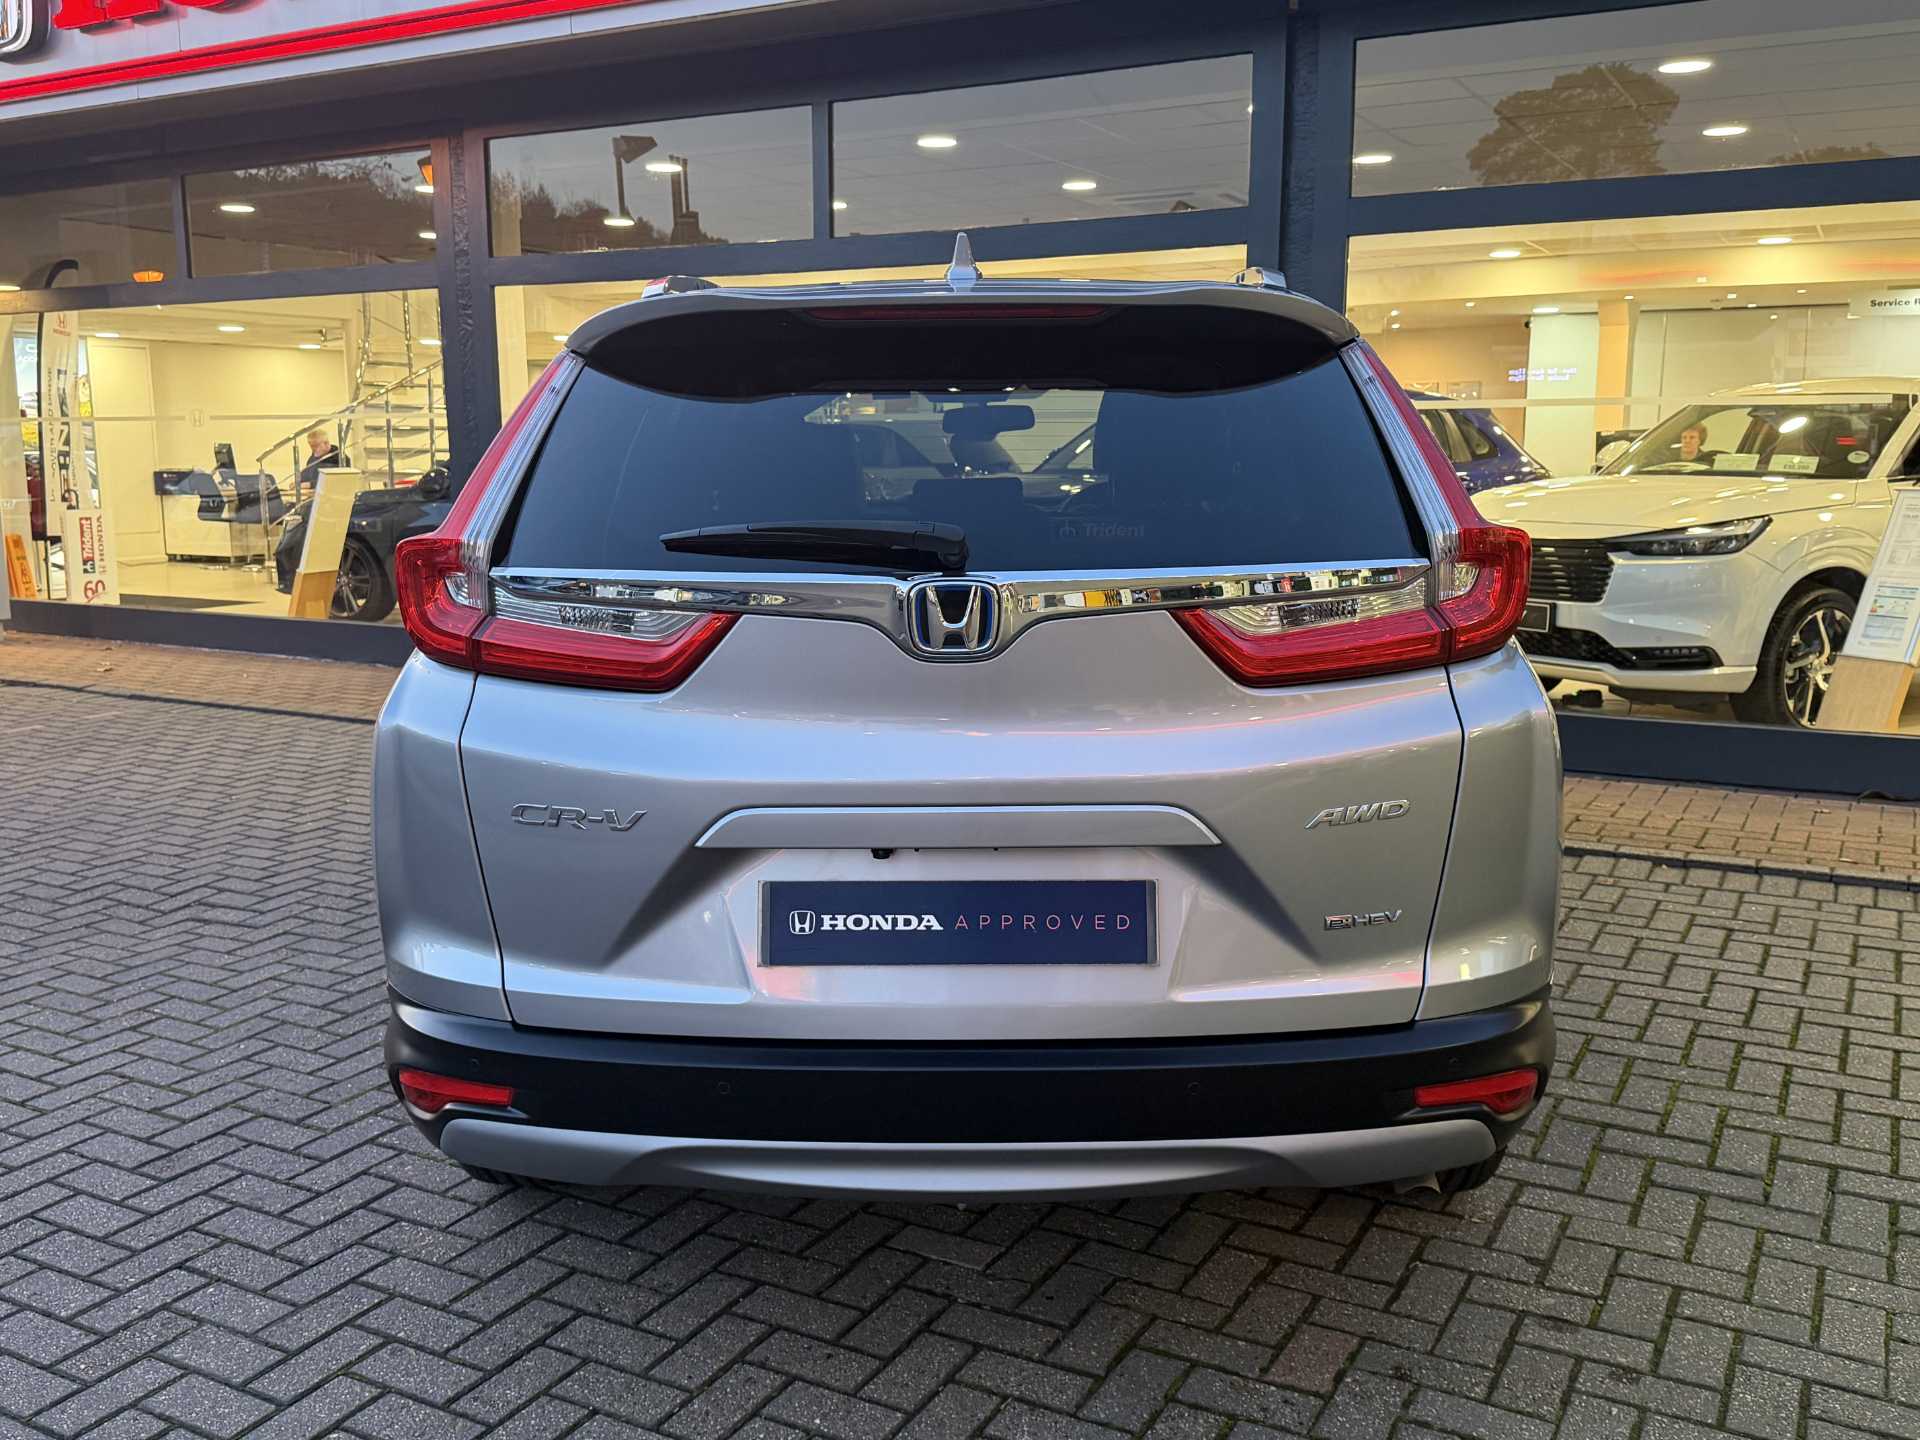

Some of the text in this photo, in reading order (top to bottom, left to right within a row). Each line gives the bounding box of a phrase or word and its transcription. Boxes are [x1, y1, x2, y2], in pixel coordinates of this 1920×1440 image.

[1870, 298, 1911, 308] Service
[81, 517, 94, 560] Trident
[96, 514, 105, 562] HONDA
[1085, 521, 1146, 538] Trident
[511, 803, 648, 832] CR-V
[1304, 799, 1411, 830] AWD
[820, 913, 1131, 931] HONDA APPROVED
